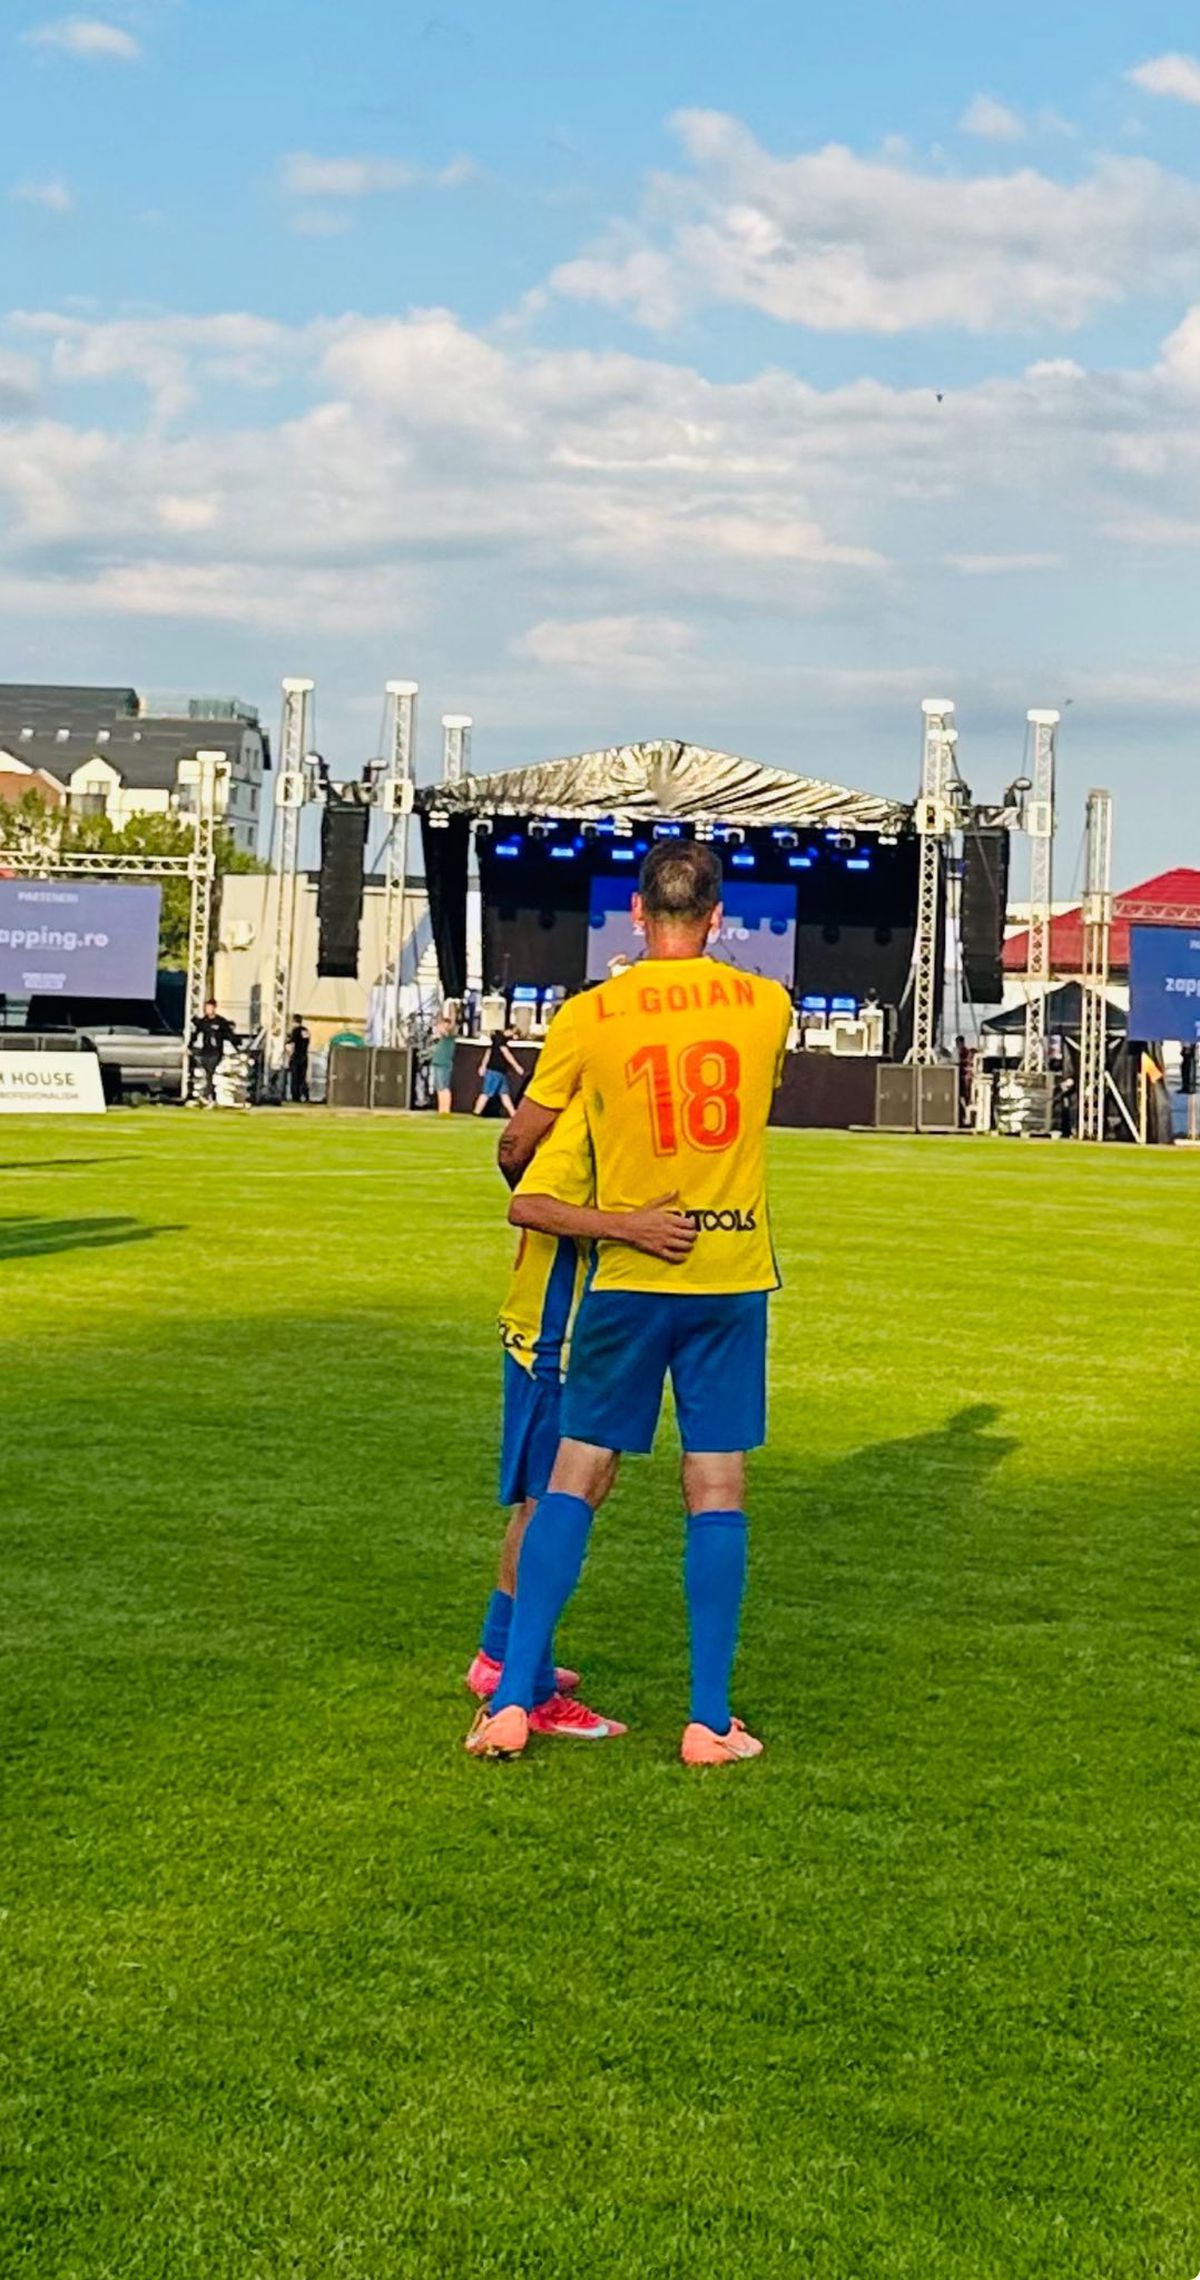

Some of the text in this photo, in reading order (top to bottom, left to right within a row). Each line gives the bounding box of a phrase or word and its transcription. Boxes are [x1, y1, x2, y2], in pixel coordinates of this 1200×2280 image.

[596, 980, 755, 1022] L. GOIAN
[11, 1072, 75, 1086] HOUSE
[624, 1039, 742, 1158] 18
